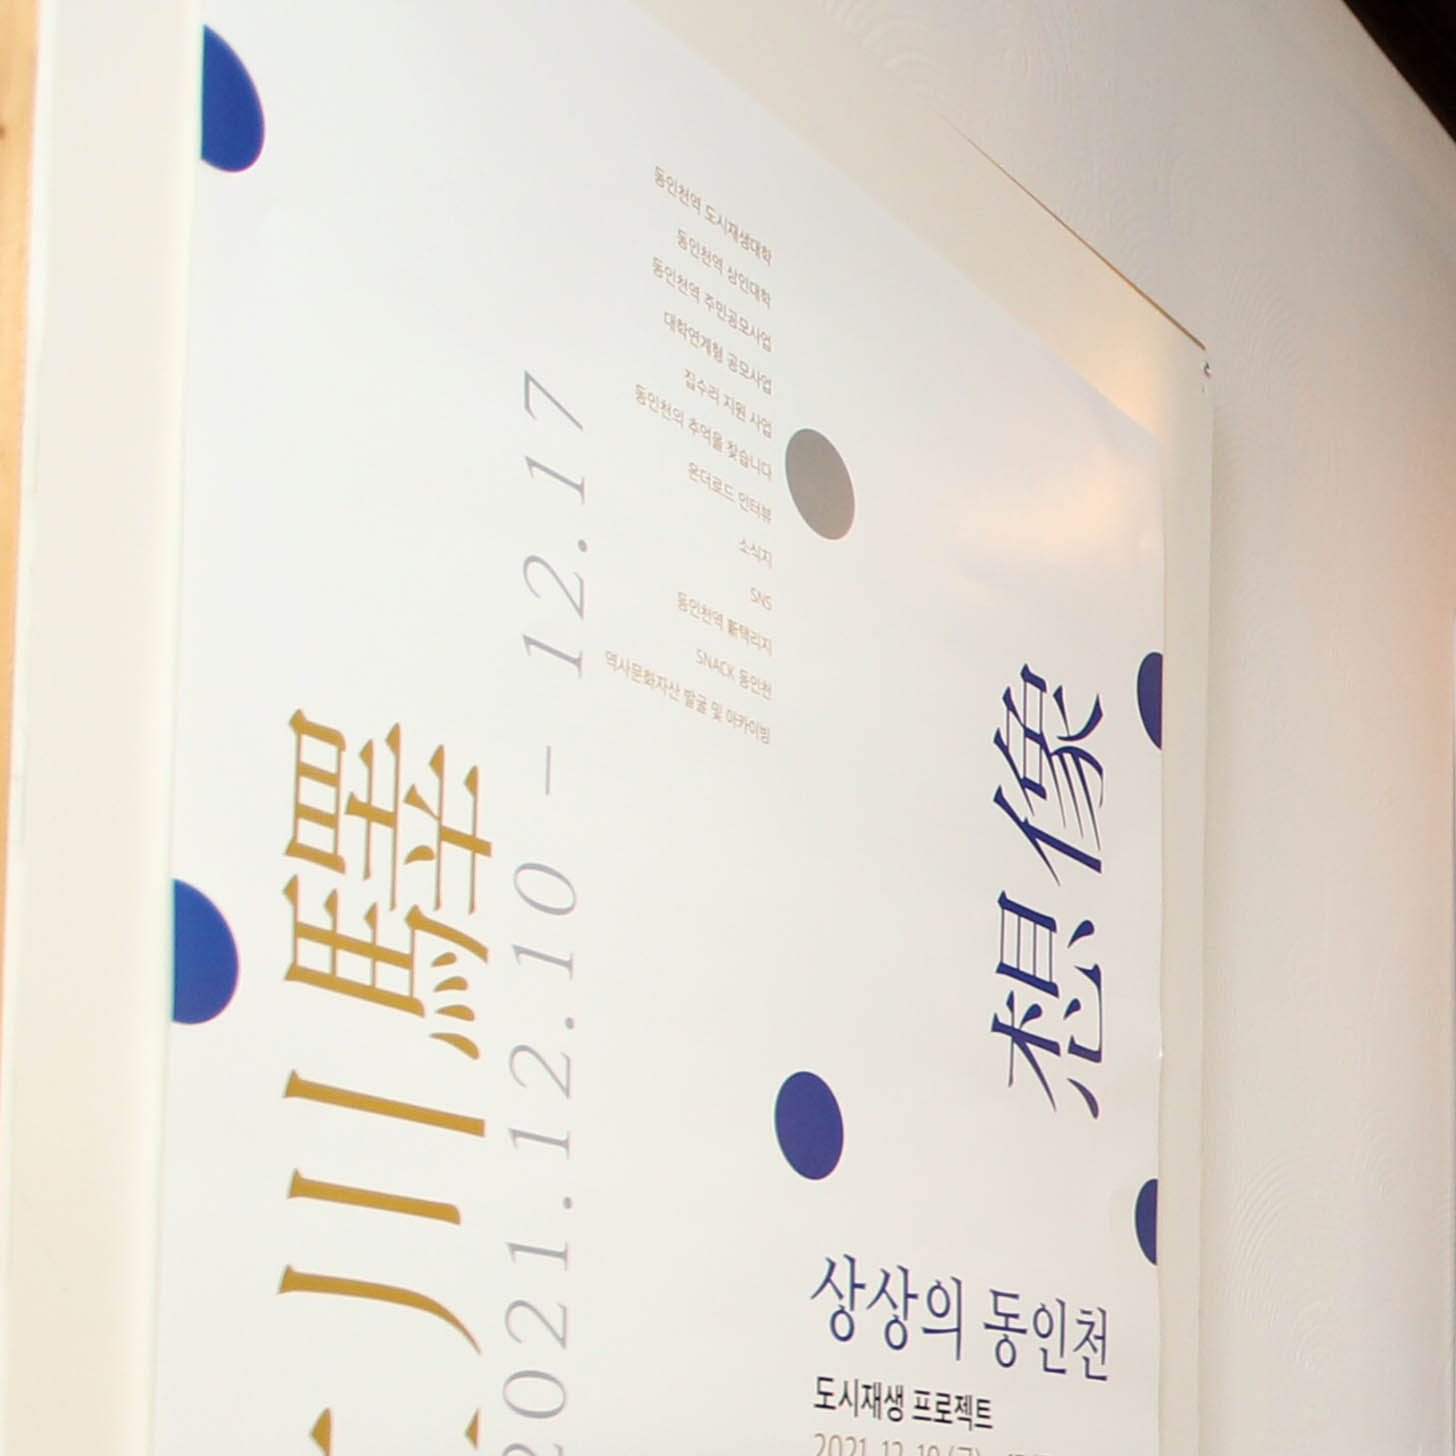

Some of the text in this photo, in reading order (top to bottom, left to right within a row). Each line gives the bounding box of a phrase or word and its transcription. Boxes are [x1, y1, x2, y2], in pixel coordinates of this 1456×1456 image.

[655, 165, 701, 215] 동인천역
[678, 228, 723, 275] 동인천역
[653, 256, 700, 304] 동인천역
[728, 352, 772, 395] 공모사업
[684, 368, 772, 439] 집수리 지원 사업
[635, 384, 684, 429] 동인천의
[727, 440, 772, 481] 찾습니다
[521, 370, 588, 679] 12.17
[738, 538, 773, 568] 소식지
[677, 591, 724, 631] 동인천역
[750, 587, 773, 611] SNS
[695, 648, 773, 701] SNACK 동인천
[990, 663, 1104, 1119] 想像
[810, 1253, 1109, 1381] 상상의 동인천
[813, 1376, 994, 1431] 도시재생 프로젝트
